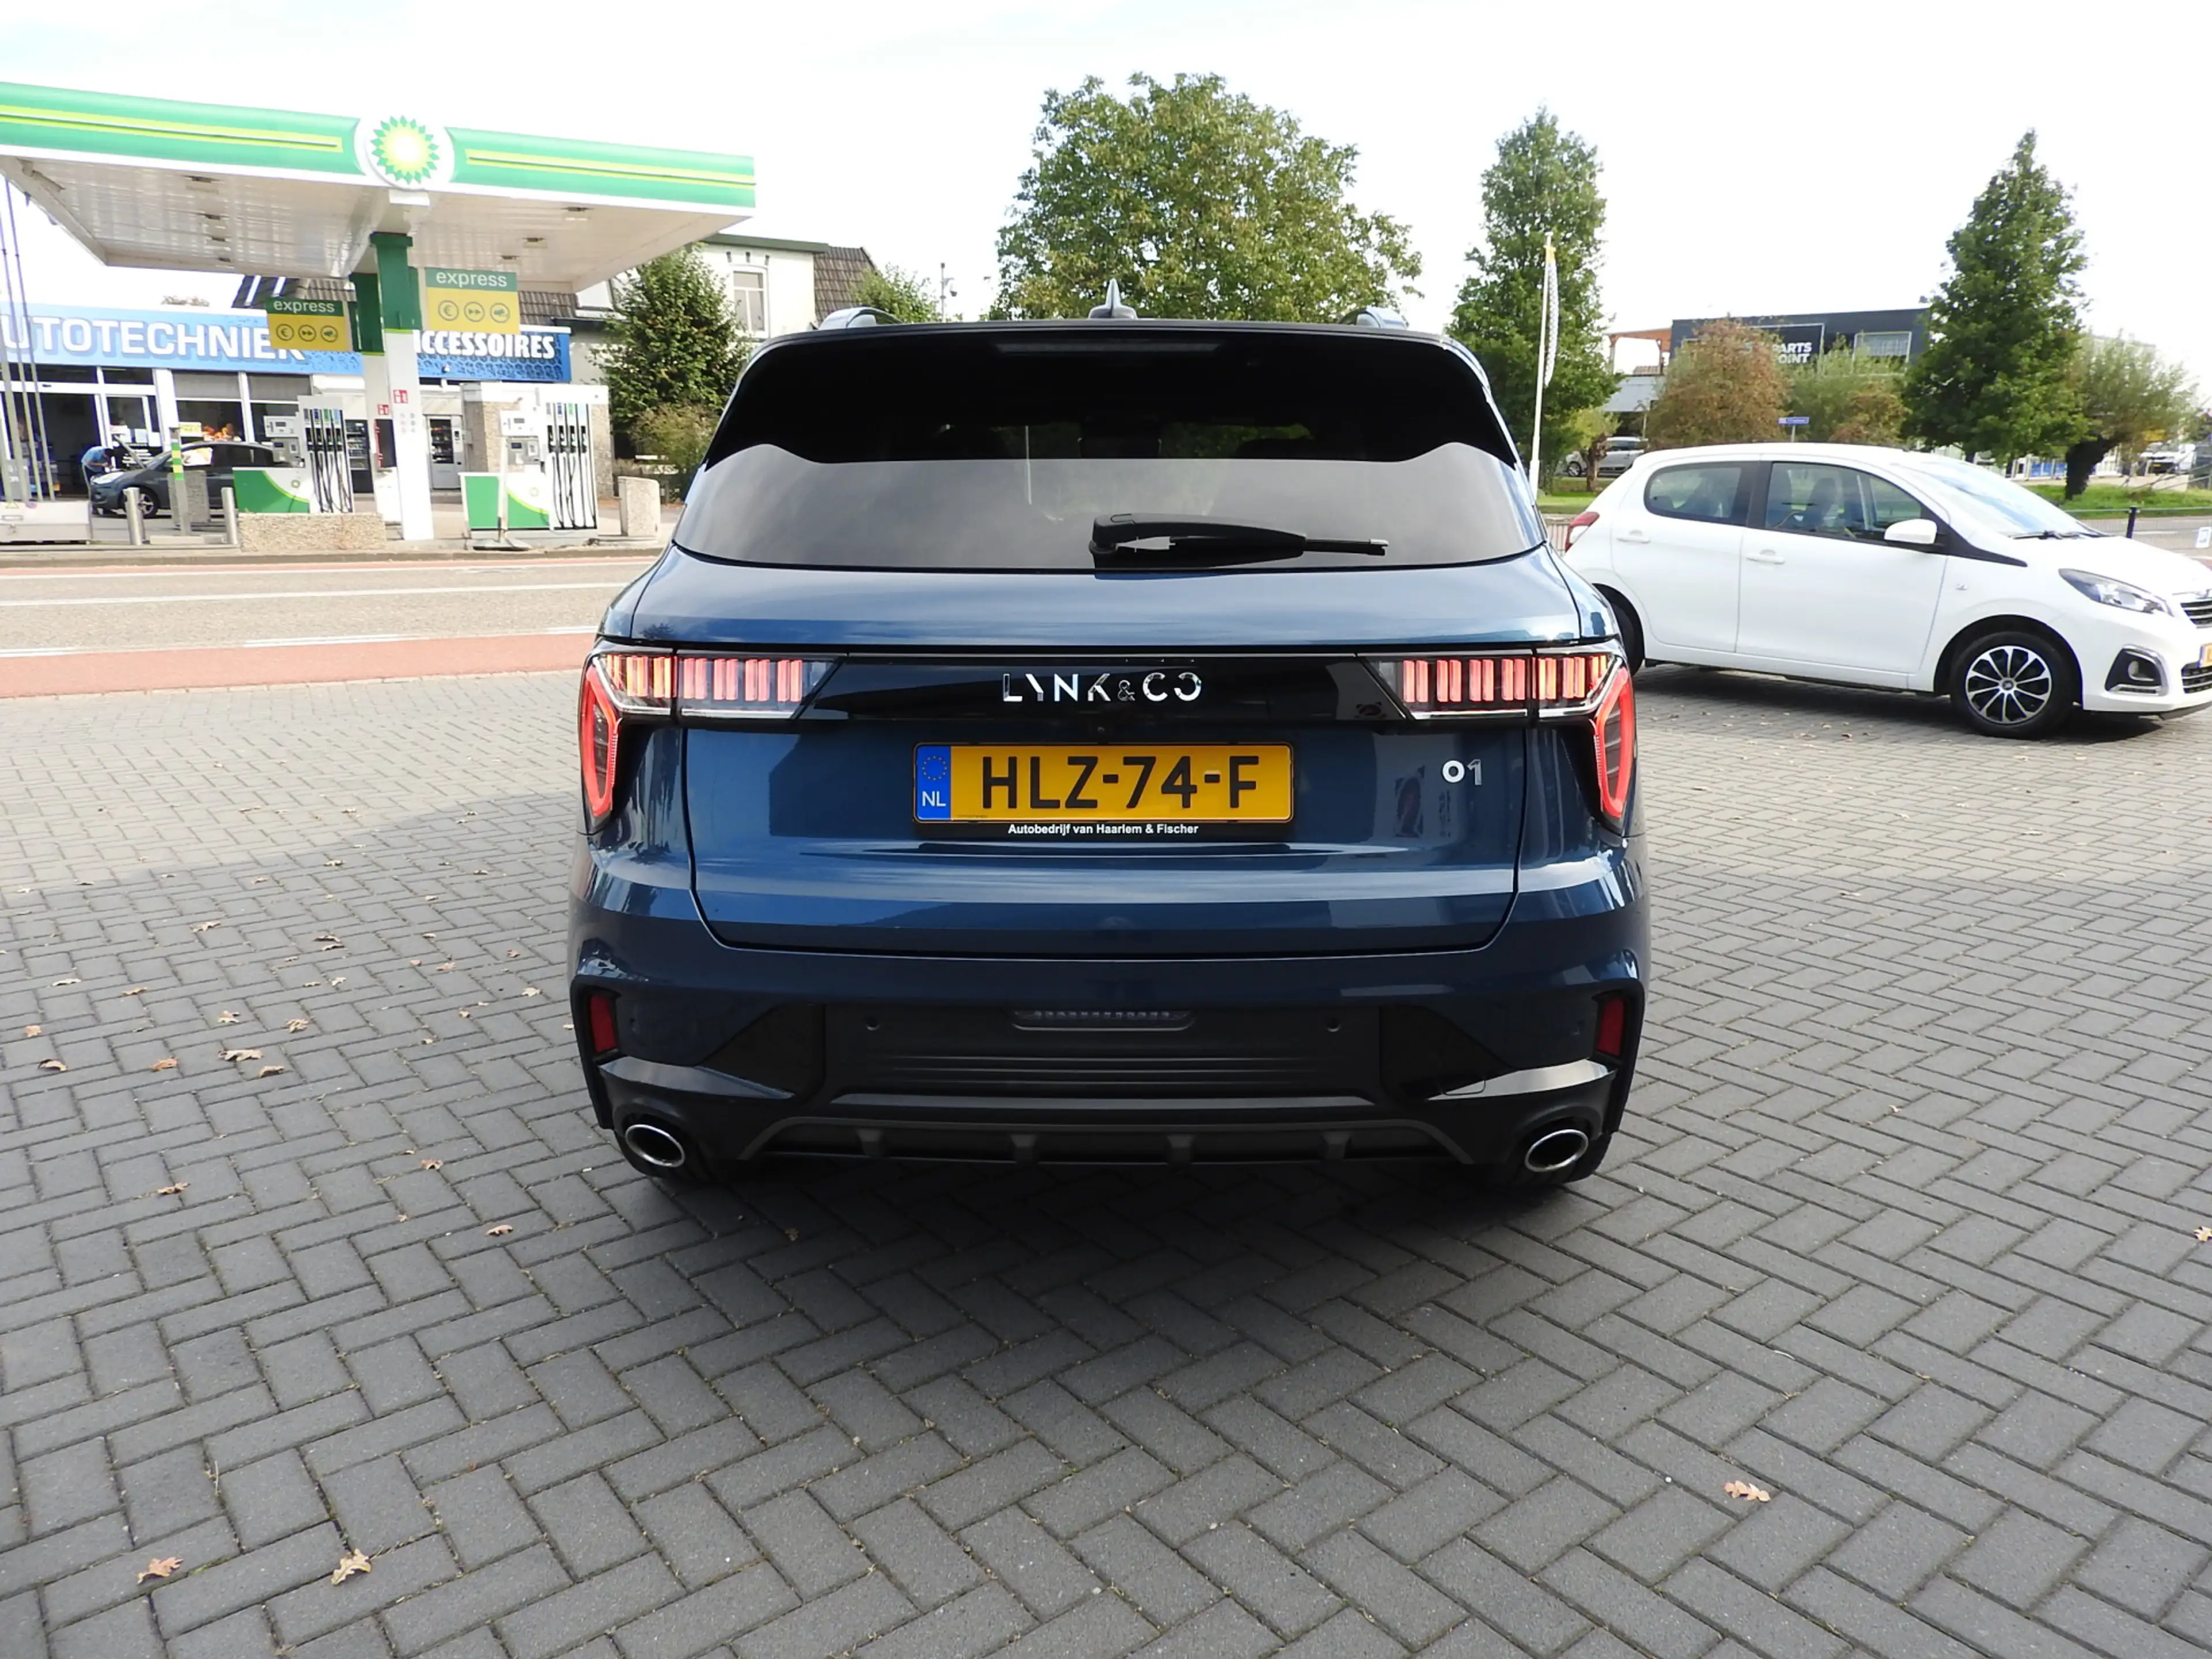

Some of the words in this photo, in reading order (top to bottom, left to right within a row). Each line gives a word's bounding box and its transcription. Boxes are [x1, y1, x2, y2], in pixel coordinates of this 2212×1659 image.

[436, 271, 507, 288] express
[273, 299, 335, 313] express
[1778, 353, 1810, 364] OINT
[982, 755, 1259, 809] HLZ-74-F
[922, 791, 946, 807] NL
[1008, 824, 1071, 836] Autobedrijf
[1073, 826, 1093, 834] van
[1096, 824, 1142, 834] Haarlem
[1145, 824, 1154, 834] &
[1157, 824, 1199, 834] Fischer
